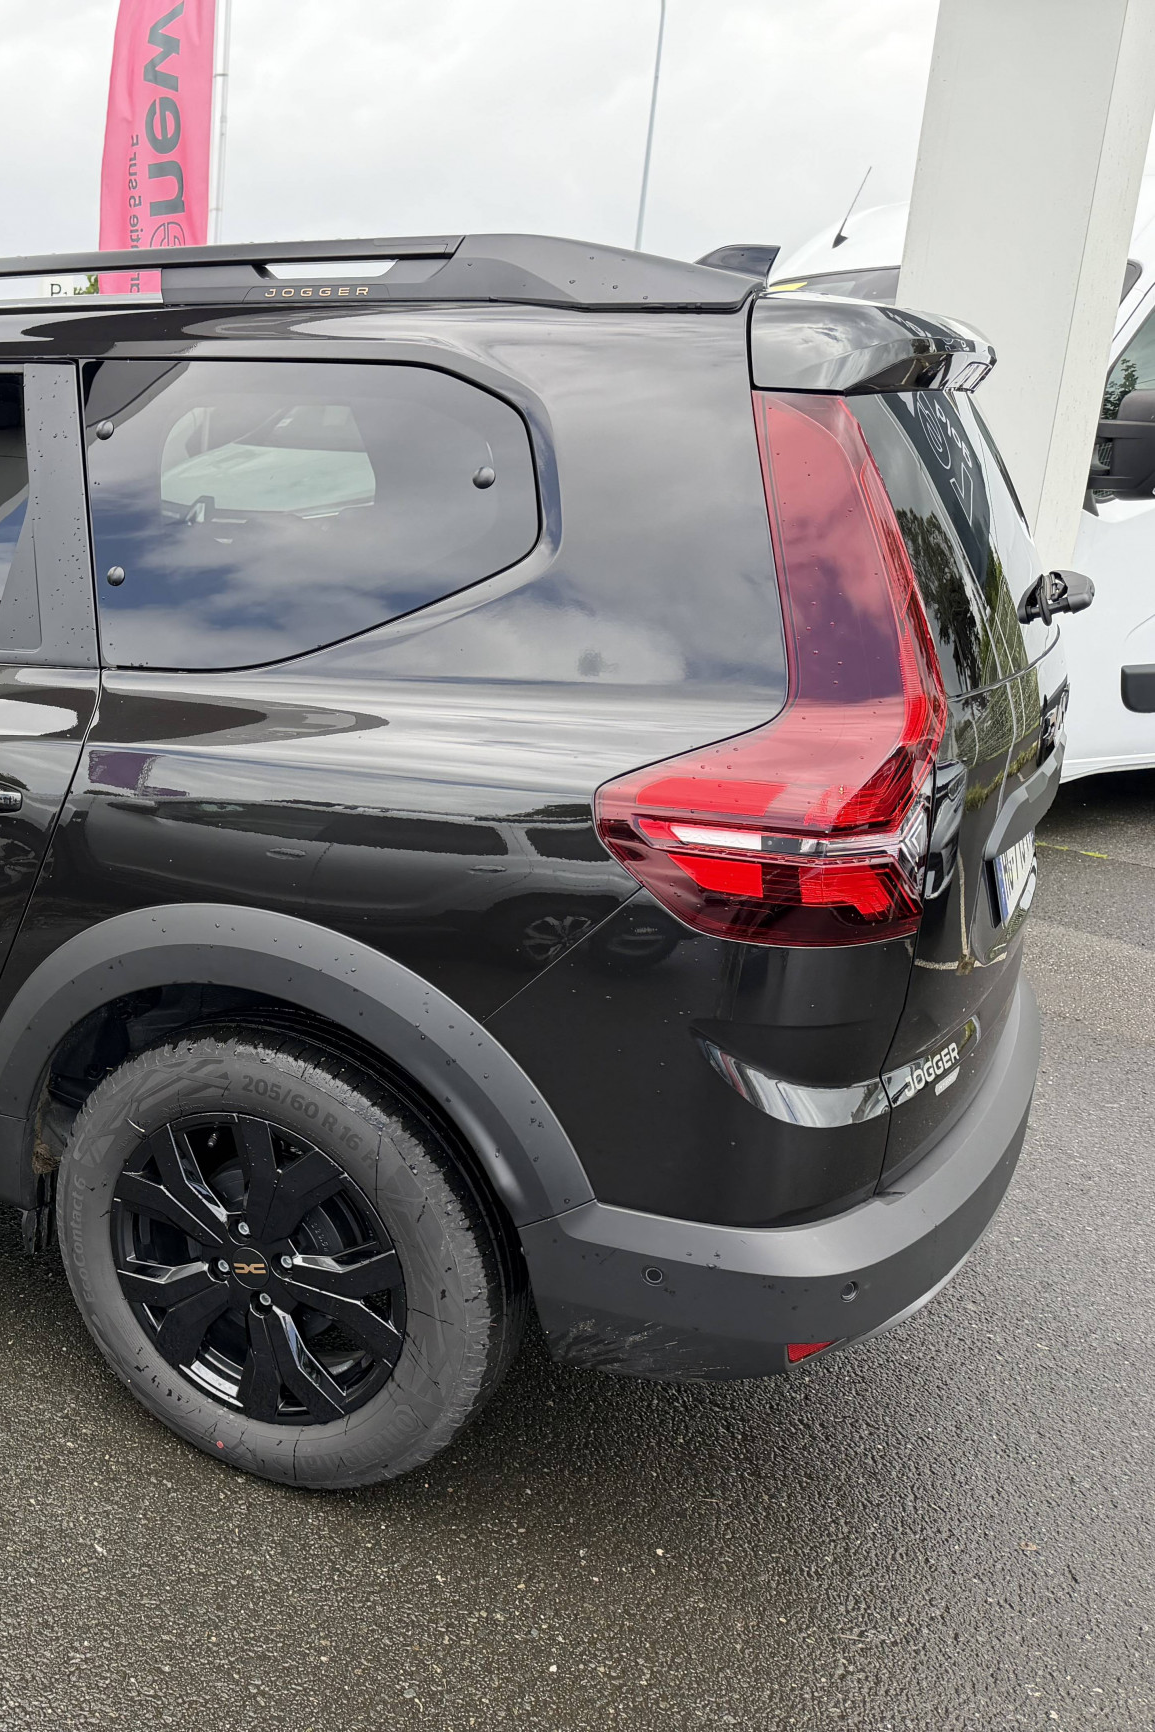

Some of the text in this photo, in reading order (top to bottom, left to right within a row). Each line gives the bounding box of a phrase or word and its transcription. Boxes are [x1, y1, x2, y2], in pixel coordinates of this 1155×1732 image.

[264, 286, 369, 298] JOGGER
[905, 1042, 959, 1097] JOGGER
[242, 1074, 320, 1120] 205/60
[321, 1112, 338, 1133] R
[339, 1126, 363, 1151] 16
[70, 1174, 95, 1302] EcoContact 6
